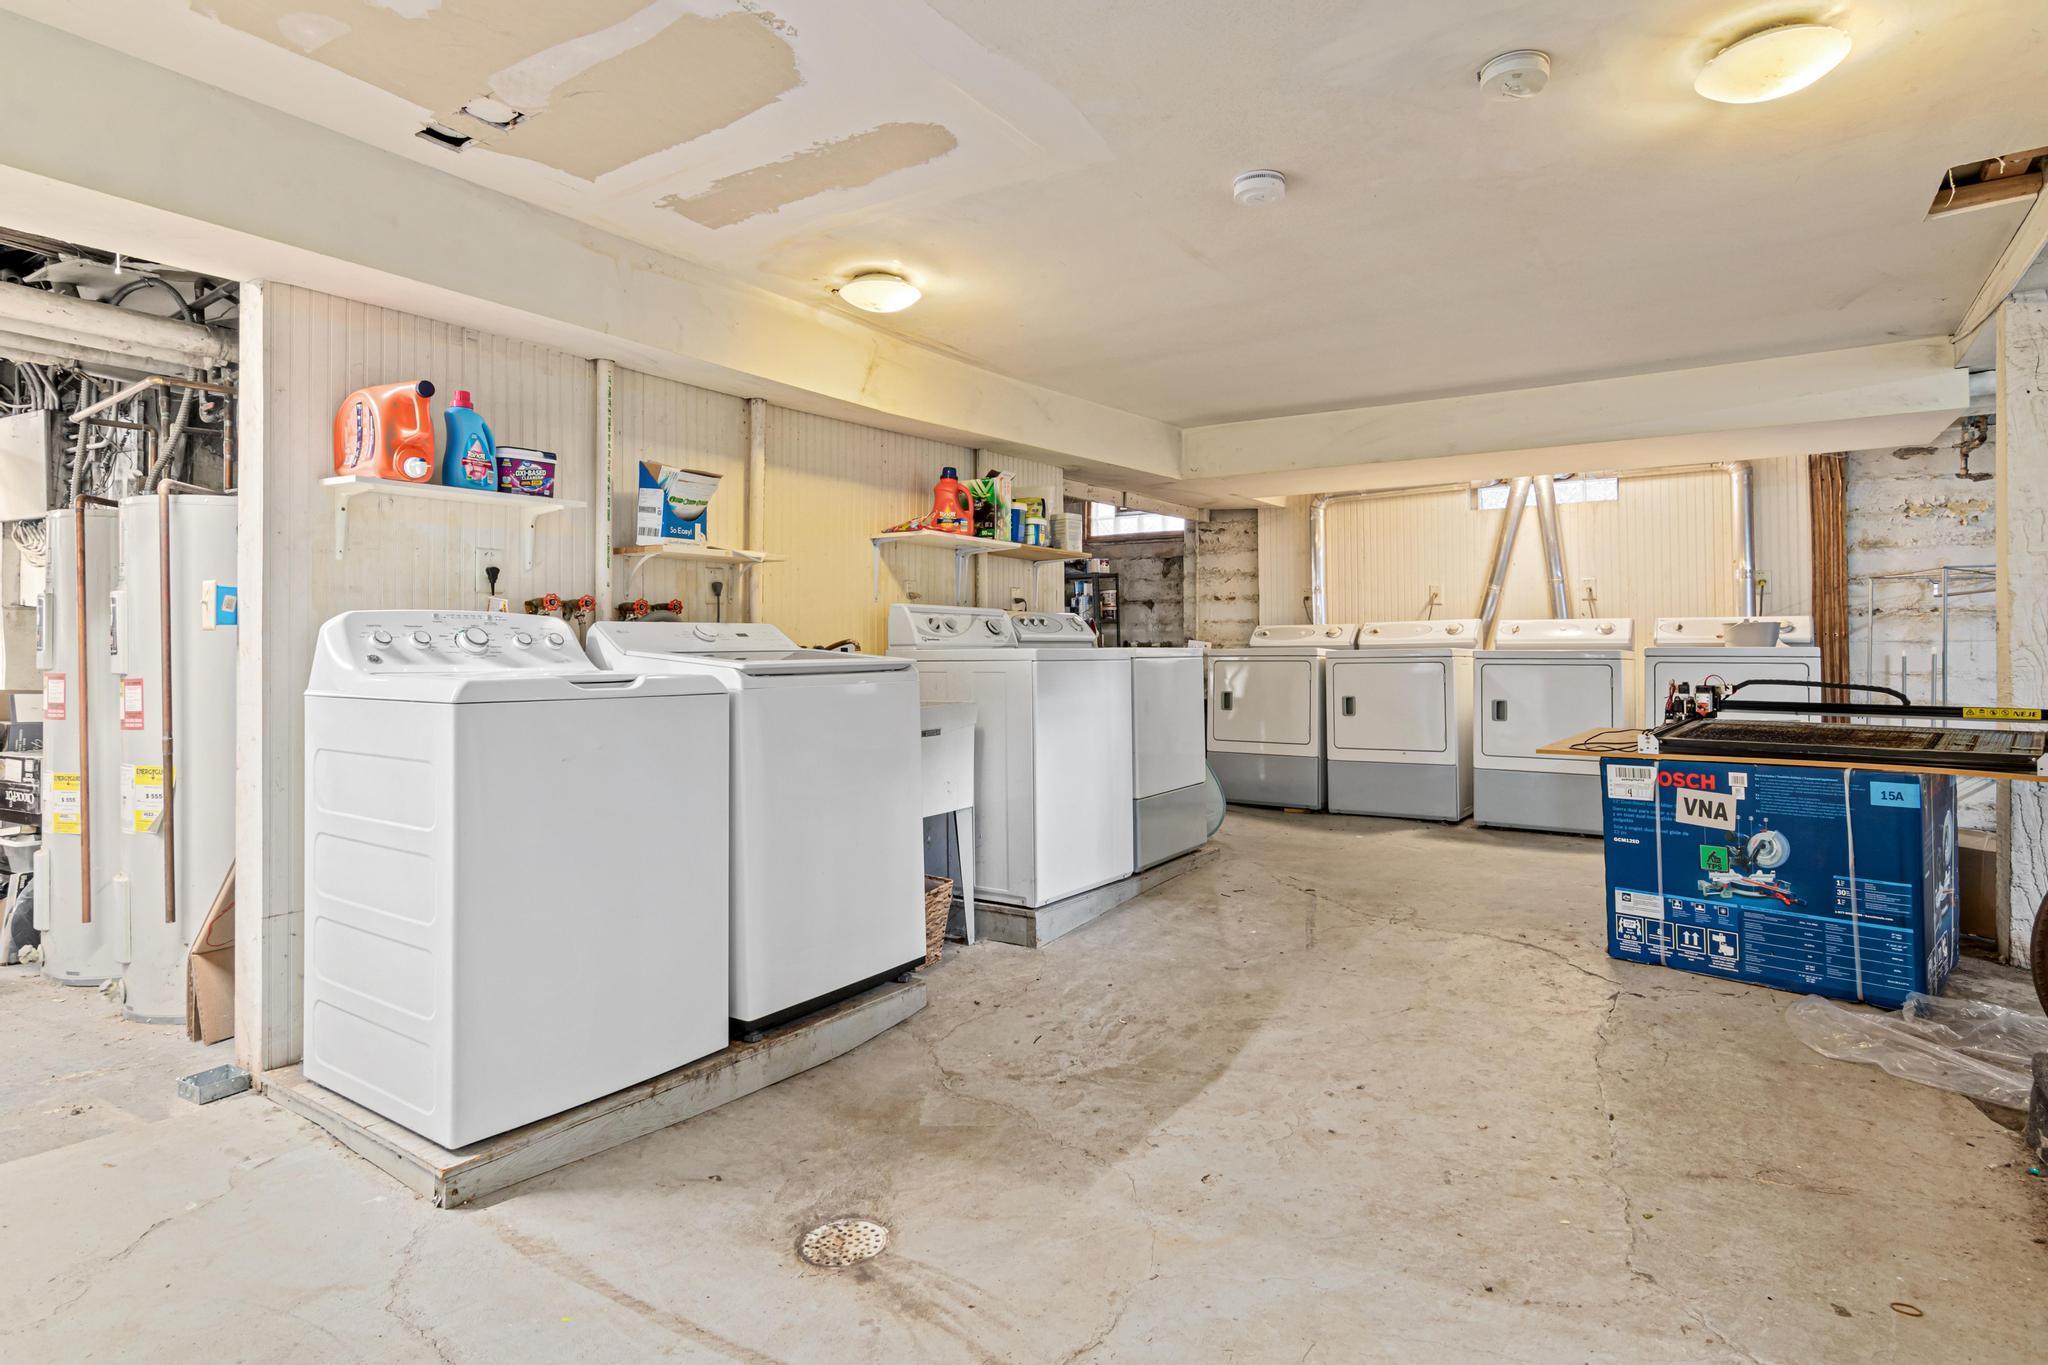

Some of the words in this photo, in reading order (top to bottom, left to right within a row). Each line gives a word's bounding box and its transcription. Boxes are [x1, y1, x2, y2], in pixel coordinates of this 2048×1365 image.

[1658, 771, 1716, 790] OSCH
[1880, 789, 1904, 802] 15A
[1683, 797, 1728, 821] VNA
